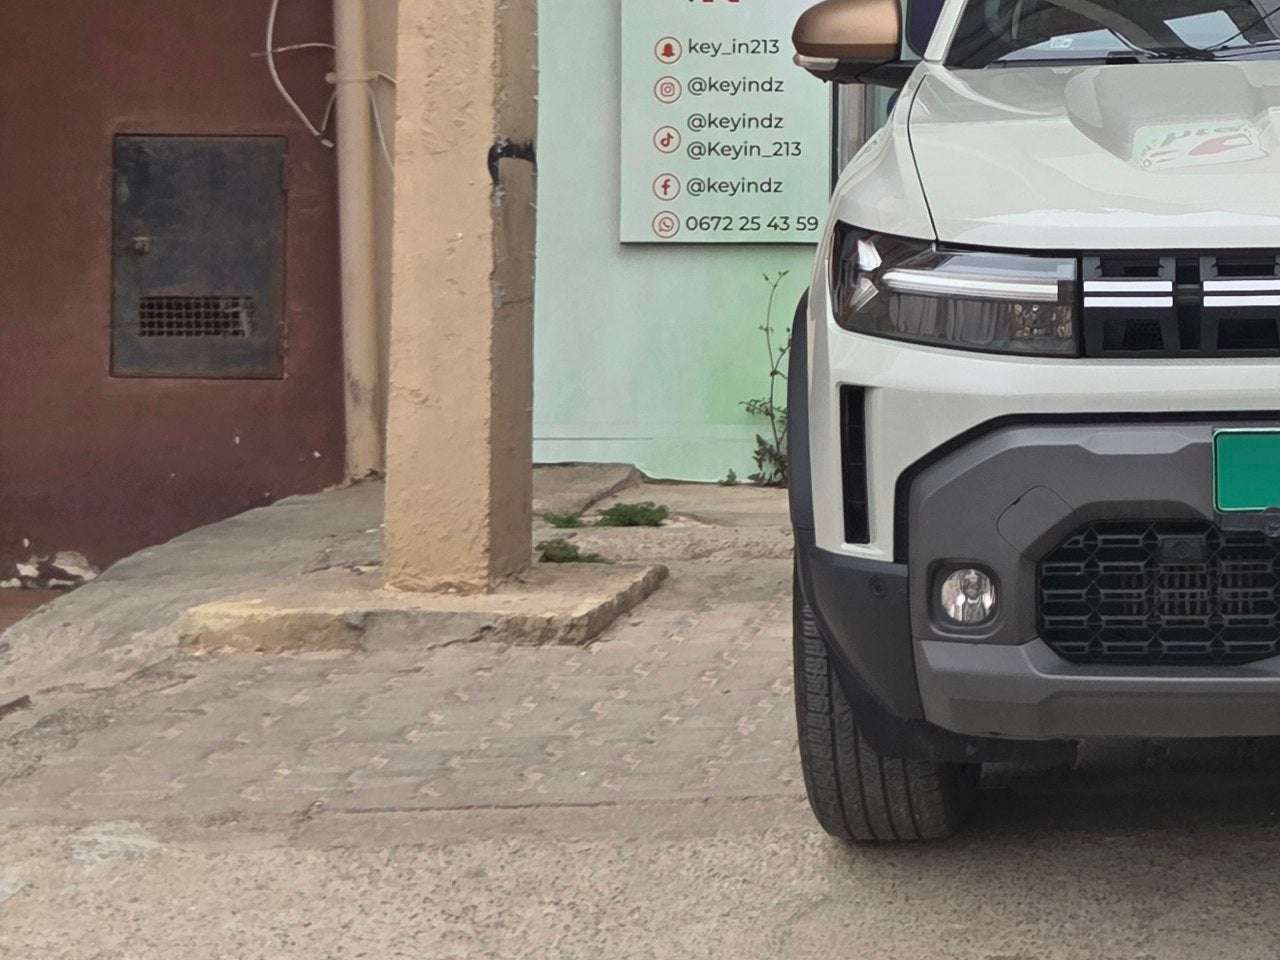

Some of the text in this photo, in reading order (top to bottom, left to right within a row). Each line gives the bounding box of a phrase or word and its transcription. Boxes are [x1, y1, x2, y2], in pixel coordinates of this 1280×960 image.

[688, 38, 780, 57] key_in213
[687, 76, 784, 96] @keyindz
[687, 113, 784, 132] @keyindz
[686, 141, 802, 160] @Keyin_213
[686, 177, 783, 196] @keyindz
[686, 216, 819, 231] 0672 25 43 59
